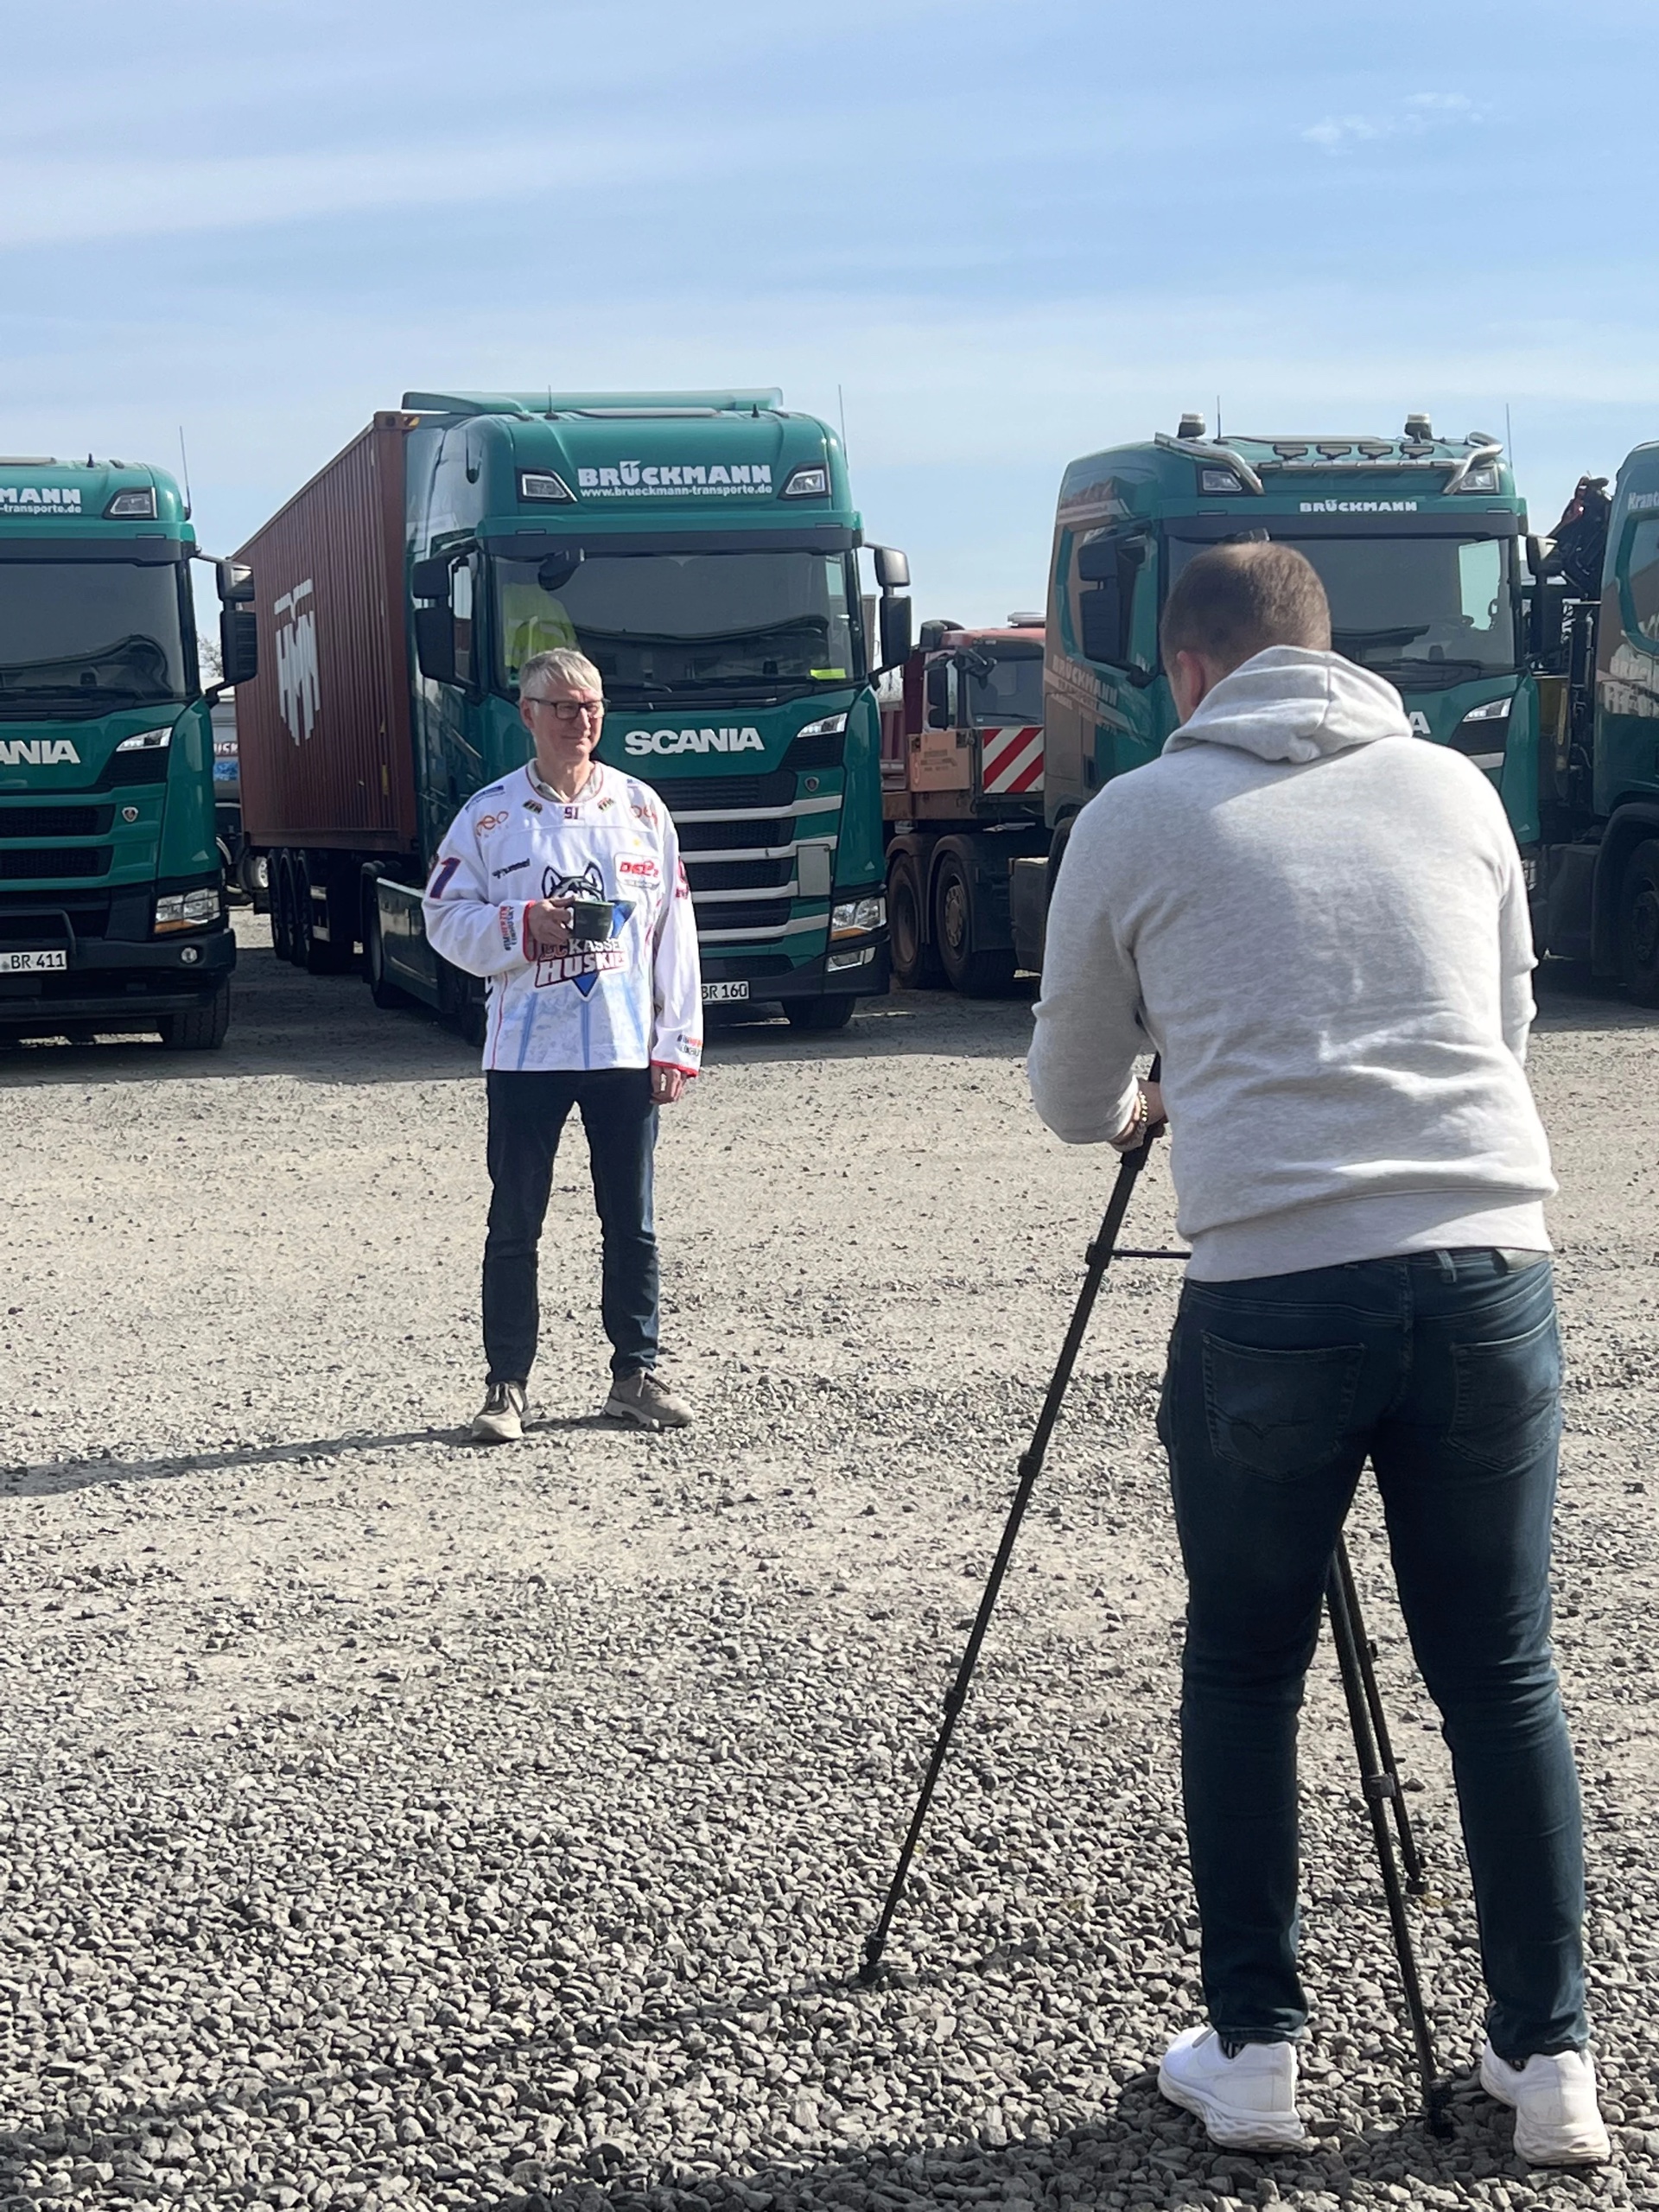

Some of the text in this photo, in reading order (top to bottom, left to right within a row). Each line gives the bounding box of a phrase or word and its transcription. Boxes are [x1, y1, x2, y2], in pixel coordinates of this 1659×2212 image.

[577, 461, 772, 486] BRÜCKMANN
[0, 487, 81, 505] MANN
[580, 484, 772, 497] www.brueckmann-transporte.de
[1300, 499, 1417, 512] BRÜCKMANN
[625, 728, 765, 755] SCANIA
[11, 953, 65, 969] BR 411
[702, 983, 747, 1000] BR 160
